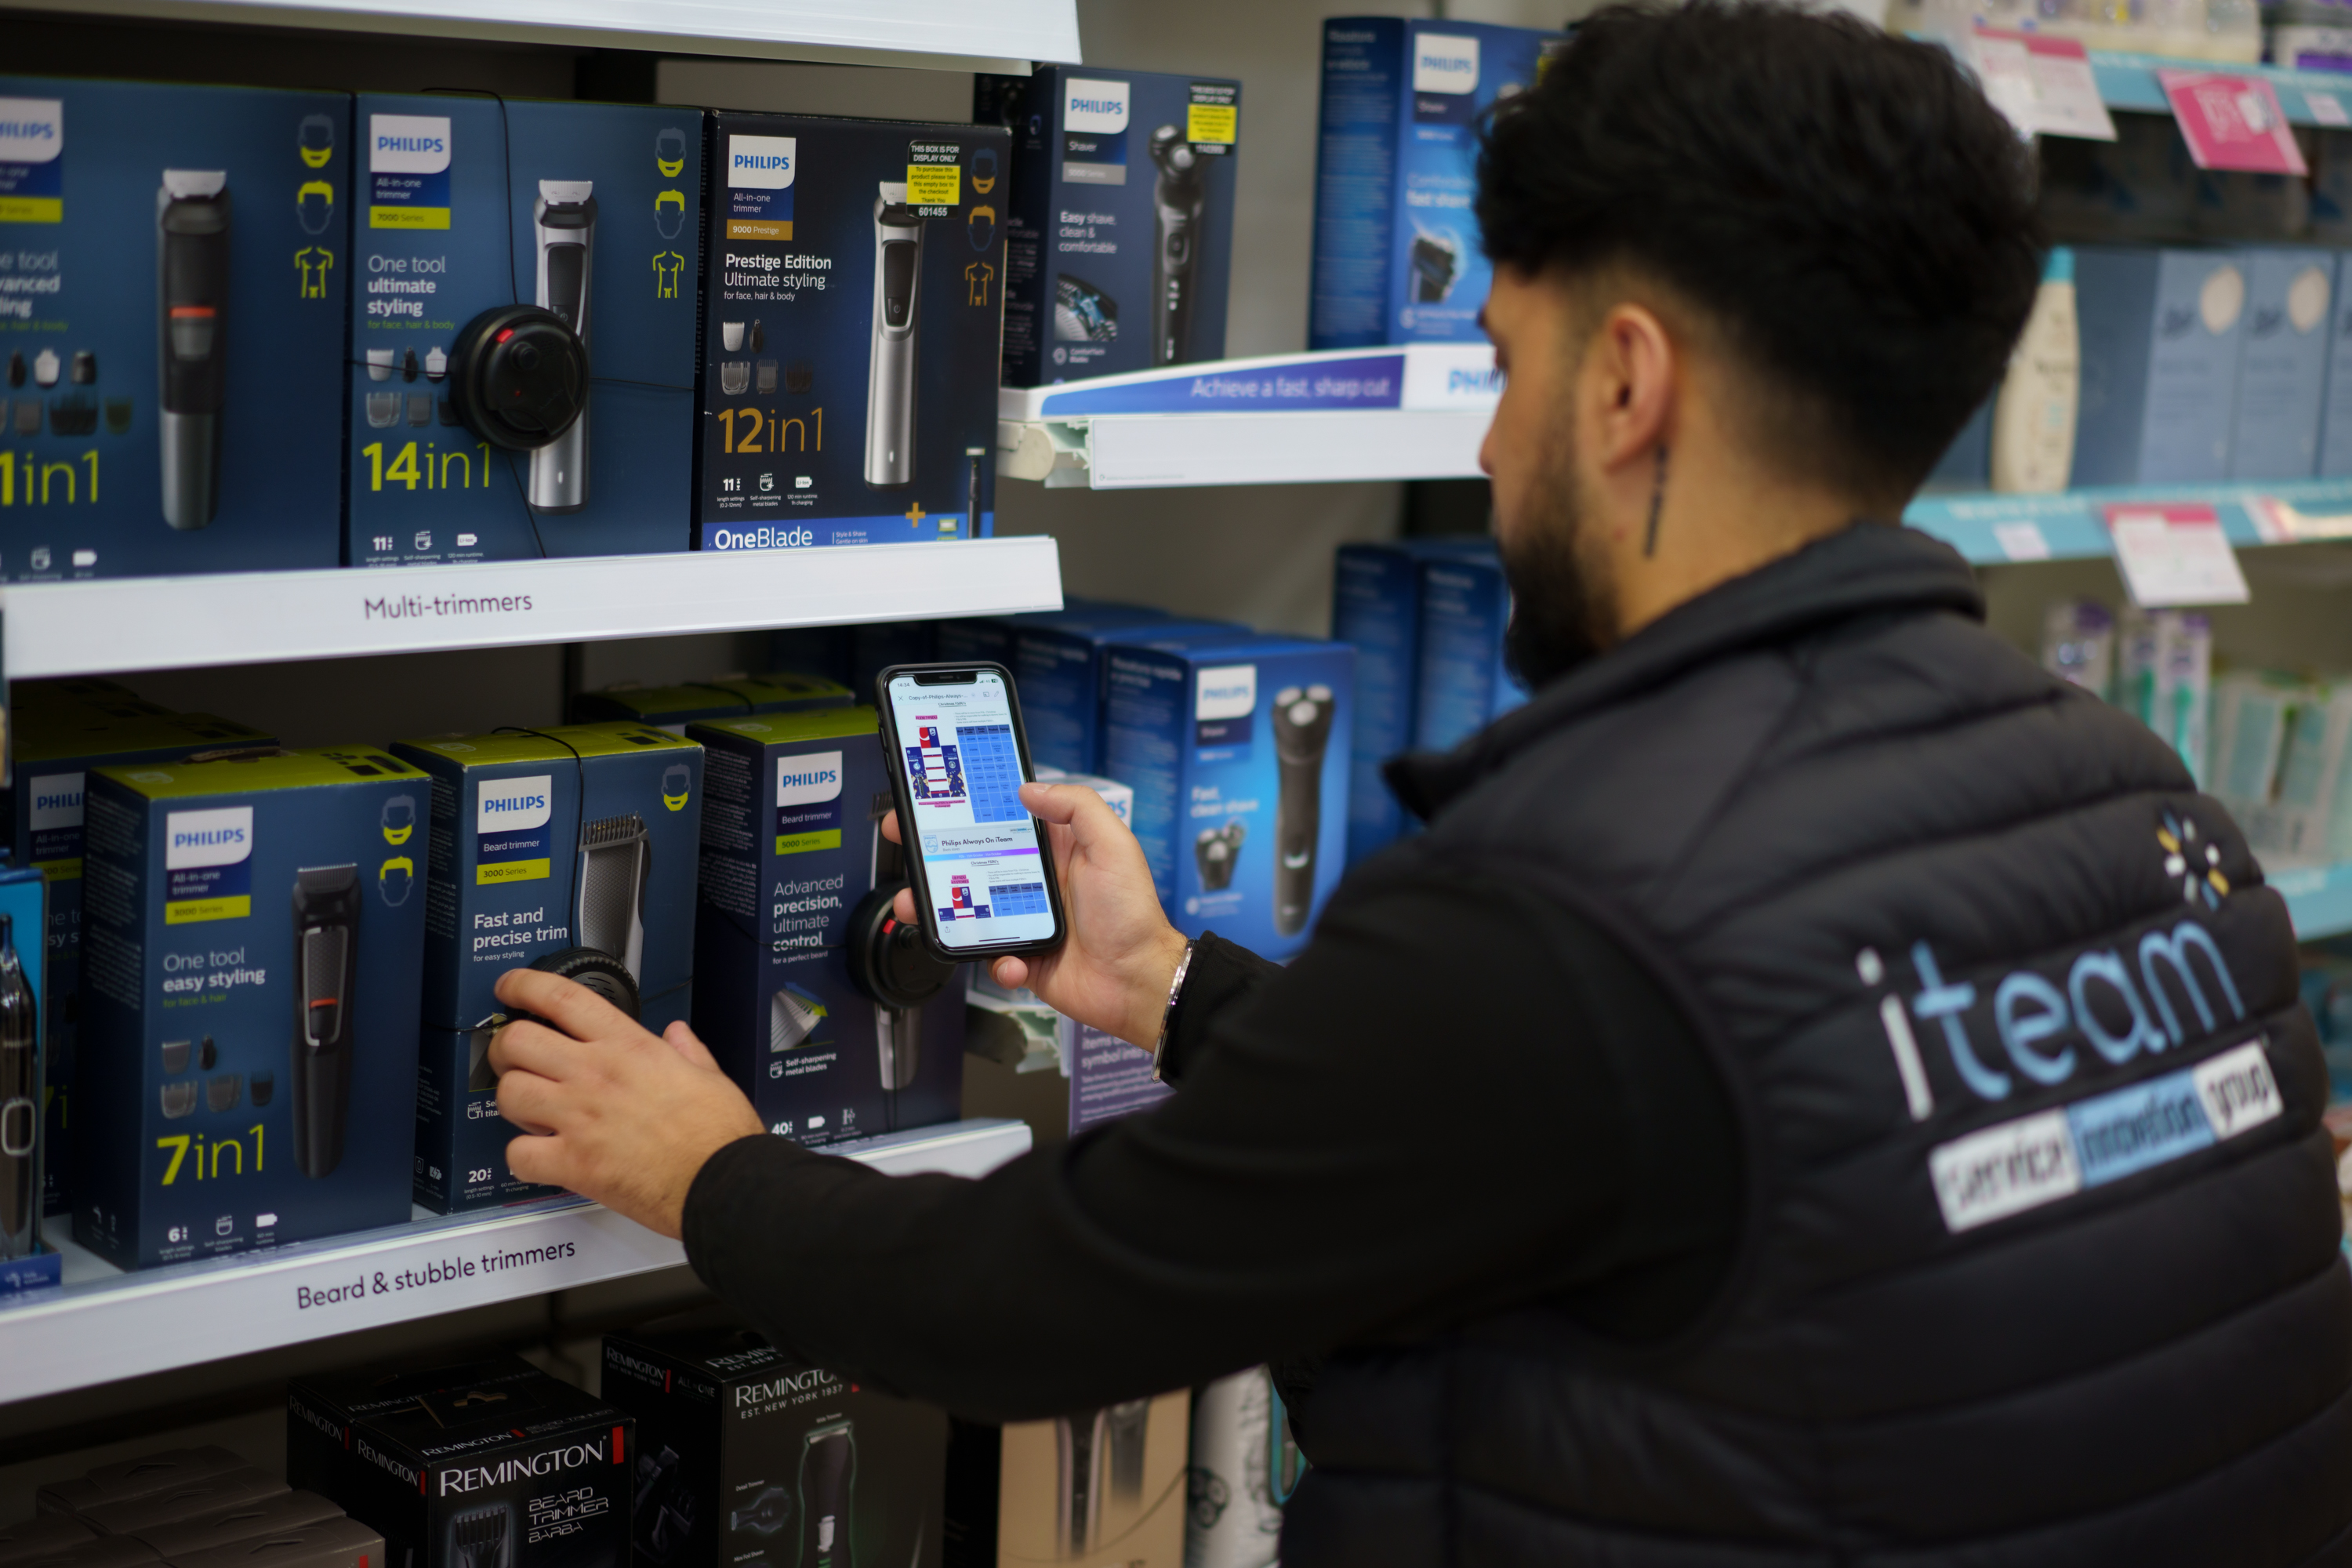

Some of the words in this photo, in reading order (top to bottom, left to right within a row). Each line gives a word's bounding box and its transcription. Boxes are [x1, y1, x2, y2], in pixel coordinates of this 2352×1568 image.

[1071, 98, 1123, 115] PHILIPS
[377, 136, 444, 154] PHILIPS
[1068, 140, 1098, 153] Shaver
[734, 154, 789, 170] PHILIPS
[376, 177, 422, 190] All-in-one
[376, 188, 411, 201] trimmer
[734, 193, 771, 203] All-in-one
[377, 212, 400, 222] 7000
[401, 213, 425, 223] Series
[733, 204, 762, 213] trimmer
[918, 206, 949, 216] 601455
[1060, 211, 1085, 226] Easy
[733, 225, 752, 234] 9000
[753, 226, 779, 235] Prestige
[1059, 226, 1087, 238] clean
[1088, 227, 1096, 239] &
[1058, 241, 1118, 255] comfortable
[18, 248, 59, 272] tool
[368, 254, 408, 273] One
[412, 255, 446, 274] tool
[726, 253, 781, 271] Prestige
[785, 255, 832, 270] Edition
[368, 278, 436, 295] ultimate
[724, 271, 780, 288] Ultimate
[783, 273, 826, 291] styling
[724, 291, 734, 299] for
[735, 291, 753, 300] face,
[754, 292, 768, 300] hair
[777, 292, 796, 302] body
[367, 298, 423, 317] styling
[406, 319, 422, 329] hair
[434, 320, 456, 332] body
[1191, 376, 1258, 398] Achieve
[1261, 381, 1270, 397] a
[717, 406, 823, 454] 12in1
[362, 441, 492, 492] 14in1
[372, 536, 387, 551] 11
[714, 525, 813, 550] OneBlade
[364, 593, 533, 621] Multi-trimmers
[782, 770, 837, 789] PHILIPS
[485, 795, 545, 815] PHILIPS
[782, 813, 804, 825] Beard
[804, 811, 833, 823] trimmer
[35, 832, 81, 846] All-in-one
[174, 828, 245, 849] PHILIPS
[484, 840, 507, 853] Beard
[509, 839, 540, 851] trimmer
[782, 839, 800, 848] 5000
[801, 837, 821, 846] Series
[35, 844, 70, 857] trimmer
[172, 870, 221, 884] All-in-one
[483, 868, 504, 878] 3000
[505, 866, 527, 877] Series
[172, 882, 209, 896] trimmer
[774, 873, 844, 898] Advanced
[198, 903, 224, 915] Series
[774, 895, 844, 919] precision,
[474, 913, 509, 930] Fast
[513, 907, 543, 924] and
[773, 914, 829, 935] ultimate
[473, 927, 532, 952] precise
[536, 924, 568, 942] trim
[772, 931, 823, 952] control
[163, 951, 208, 972] One
[209, 946, 245, 967] tool
[485, 953, 501, 963] easy
[502, 949, 525, 960] styling
[788, 952, 810, 964] perfect
[810, 950, 829, 960] beard
[162, 973, 206, 994] easy
[208, 967, 267, 990] styling
[786, 1051, 837, 1069] Self-sharpening
[1081, 1047, 1123, 1072] symbol
[786, 1065, 805, 1077] metal
[805, 1062, 828, 1072] blades
[156, 1123, 265, 1186] 7in1
[468, 1168, 488, 1184] 20
[477, 1184, 495, 1192] settings
[297, 1275, 365, 1311] Beard
[371, 1271, 390, 1295] &
[394, 1255, 477, 1291] stubble
[481, 1239, 576, 1275] trimmers
[605, 1345, 665, 1382] REMINGTON
[697, 1381, 716, 1399] ONE
[740, 1408, 761, 1421] EST.
[764, 1399, 787, 1414] NEW
[791, 1392, 818, 1407] YORK
[822, 1383, 844, 1398] 1937
[289, 1393, 343, 1444] REMINGTON
[421, 1431, 513, 1458] REMINGTON
[358, 1436, 419, 1488] REMINGTON
[439, 1437, 608, 1498] REMINGTON
[748, 1479, 765, 1488] Trimmer
[528, 1486, 593, 1512] BEARD
[528, 1495, 610, 1527] TRIMMER
[528, 1521, 584, 1544] BARBA
